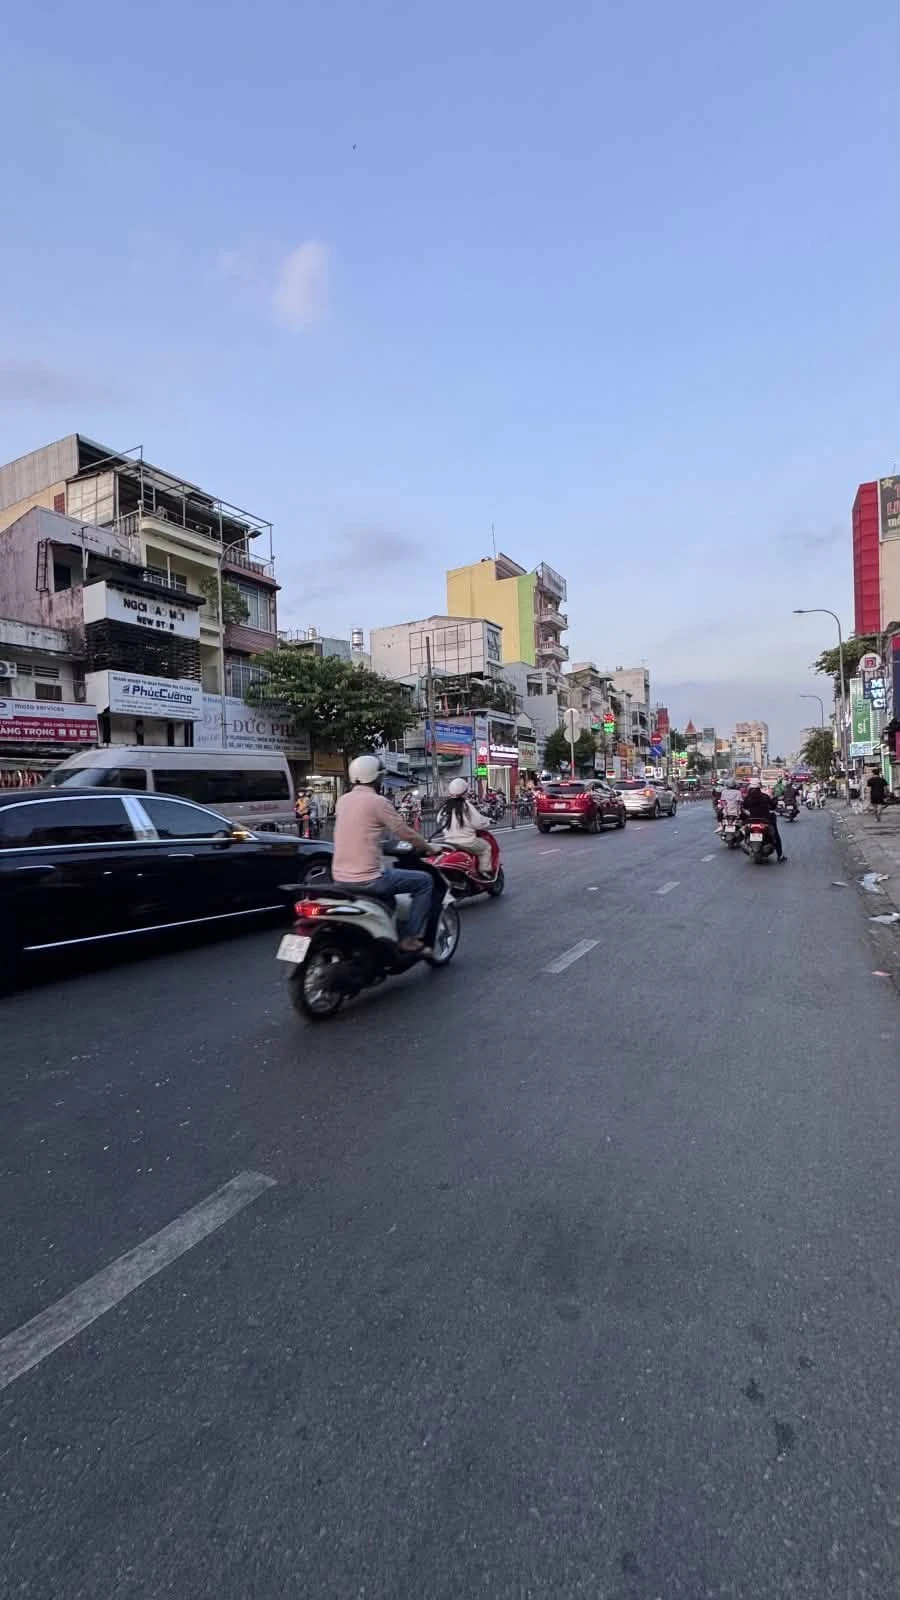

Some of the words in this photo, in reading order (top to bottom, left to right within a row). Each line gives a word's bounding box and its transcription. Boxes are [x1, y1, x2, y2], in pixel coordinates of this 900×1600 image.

[137, 615, 154, 626] NEW
[156, 620, 175, 631] STR
[36, 704, 65, 712] services
[23, 727, 55, 737] TRỌNG
